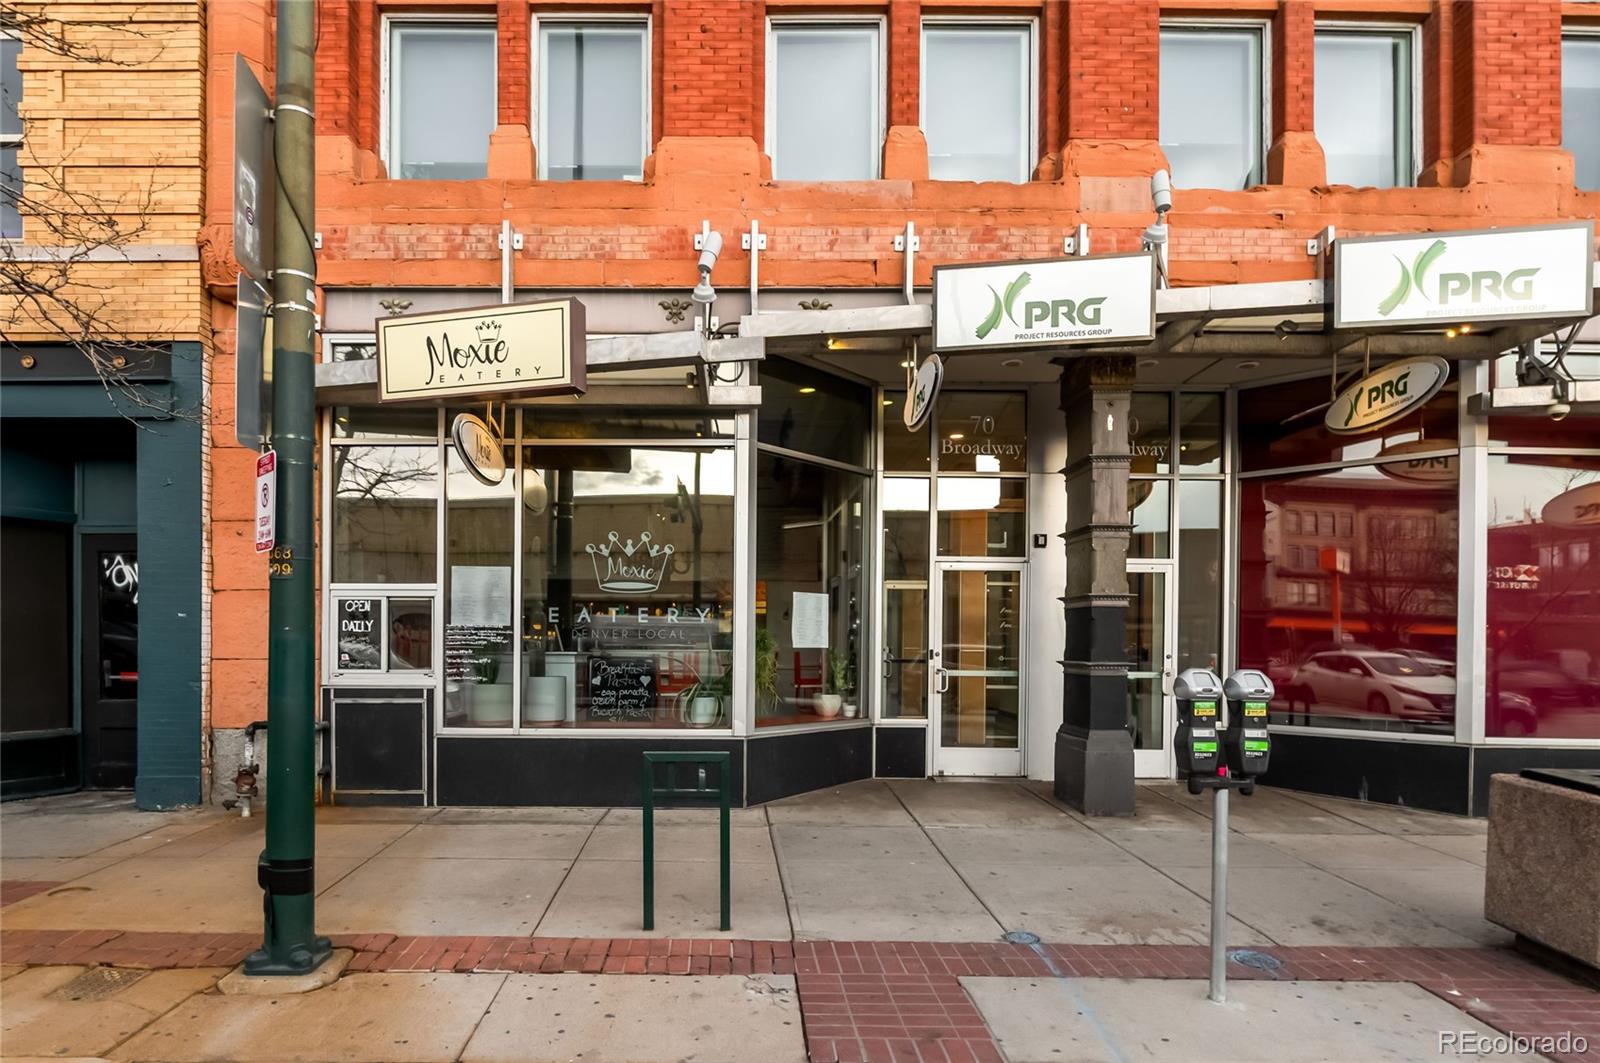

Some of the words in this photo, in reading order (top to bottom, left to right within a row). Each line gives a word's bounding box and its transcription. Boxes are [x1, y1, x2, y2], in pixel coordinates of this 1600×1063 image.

[1439, 267, 1542, 305] PRG
[1025, 297, 1108, 330] PRG
[1014, 332, 1045, 340] PROJECT
[1045, 329, 1087, 339] RESOURCES
[1087, 328, 1113, 336] GROUP
[425, 332, 509, 385] Moxie
[439, 366, 541, 383] EATERY
[1368, 371, 1411, 409] PRG
[970, 415, 995, 434] 70
[1128, 415, 1140, 436] 0
[942, 439, 1024, 459] Broadway
[603, 557, 657, 581] Moxie
[345, 600, 371, 612] OPEN
[548, 607, 710, 623] EATERY
[572, 629, 629, 639] DENVER
[638, 629, 686, 639] LOCAL
